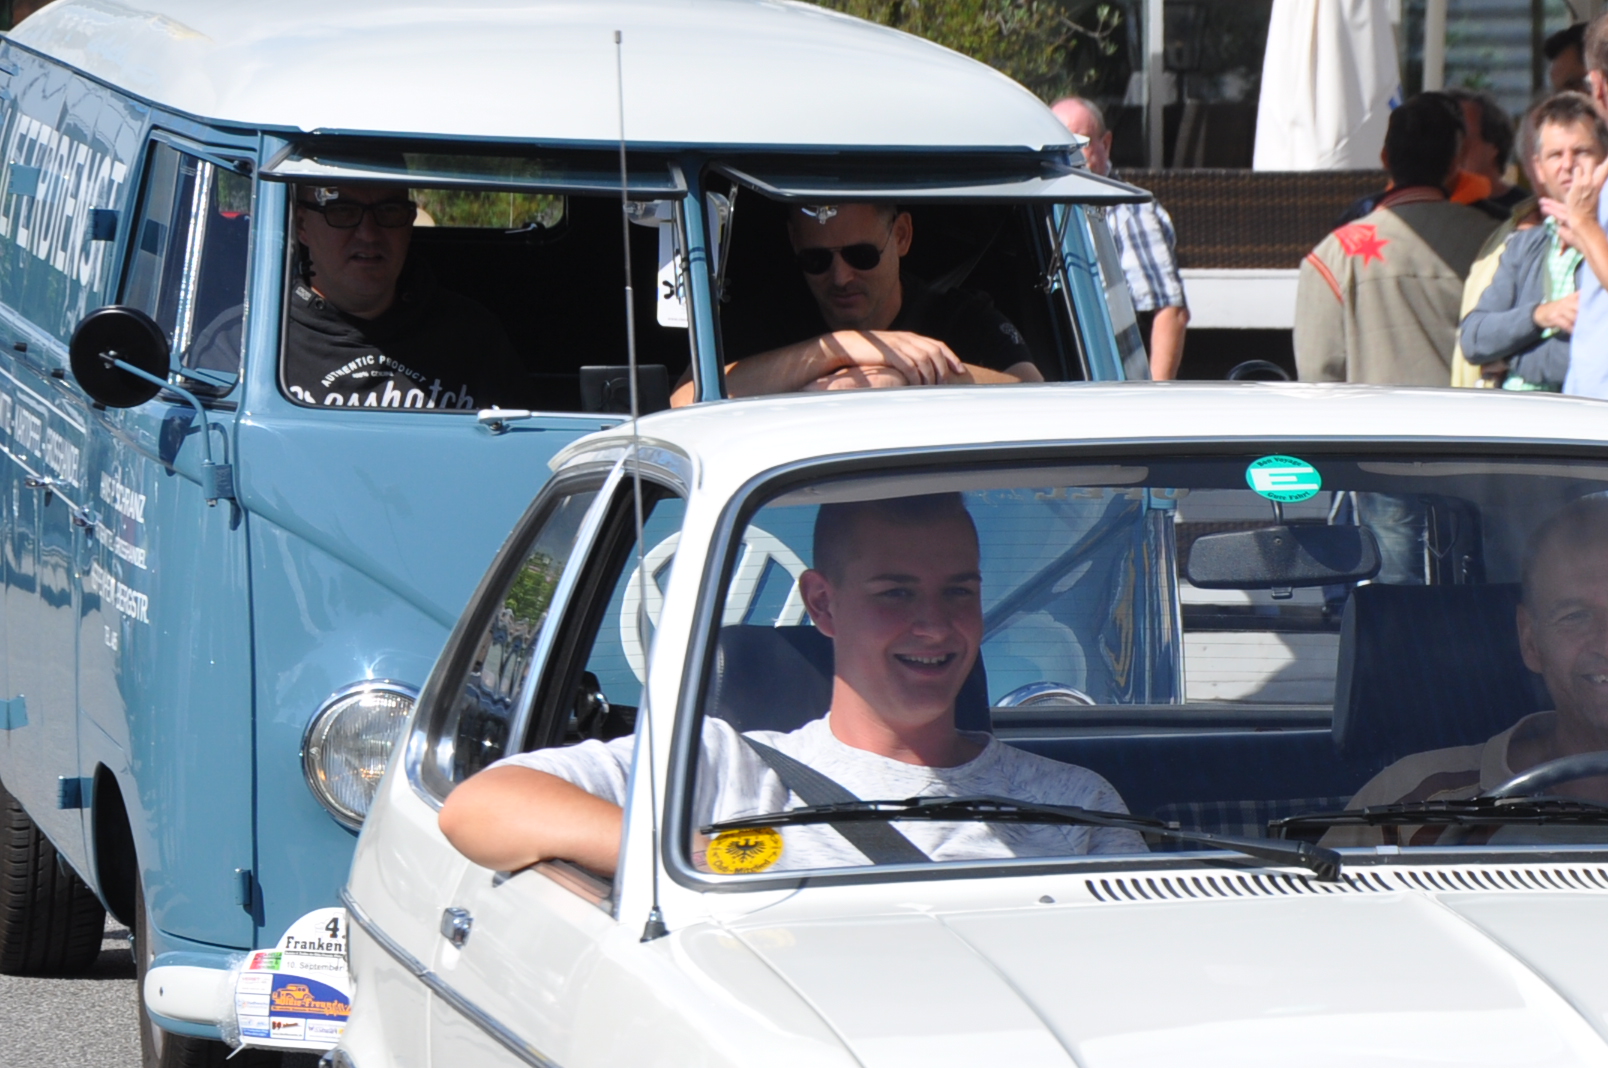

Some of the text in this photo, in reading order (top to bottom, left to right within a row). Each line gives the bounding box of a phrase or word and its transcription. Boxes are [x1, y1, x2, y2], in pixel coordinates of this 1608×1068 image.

[320, 354, 427, 388] AUTHENTIC PRODUCT
[1256, 456, 1302, 467] Bon Voyage
[1250, 467, 1320, 491] E
[1267, 491, 1311, 501] Gute Fahrt
[299, 961, 344, 972] September
